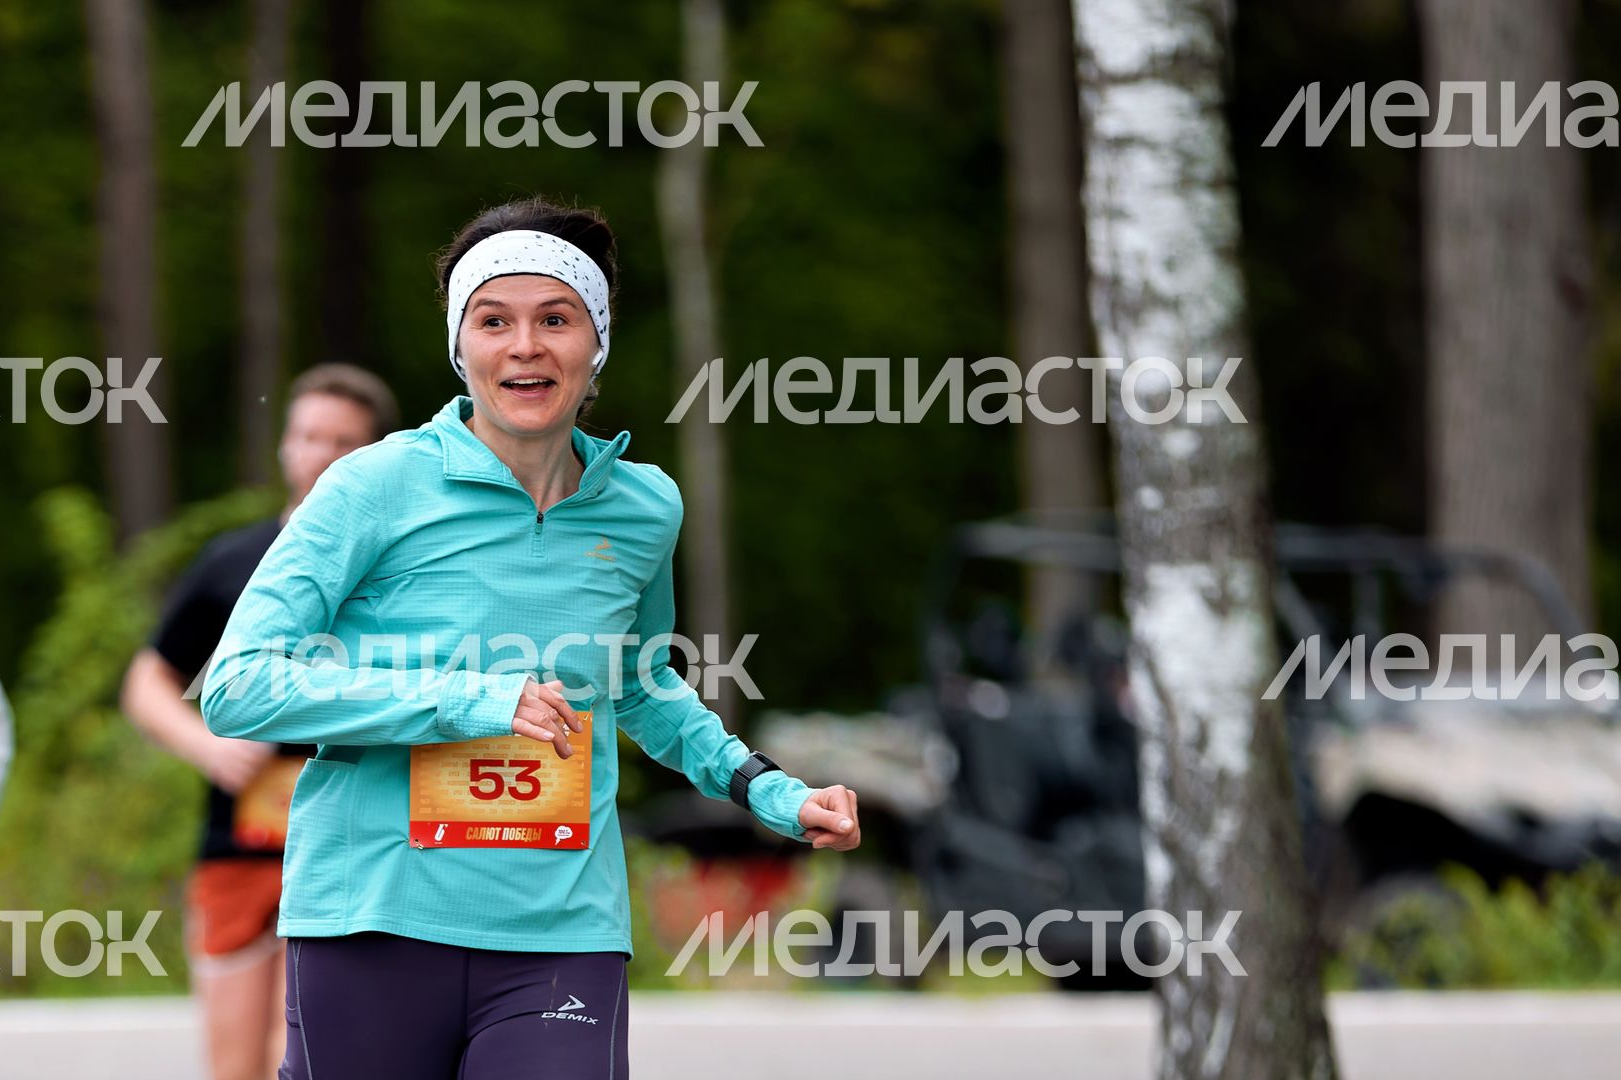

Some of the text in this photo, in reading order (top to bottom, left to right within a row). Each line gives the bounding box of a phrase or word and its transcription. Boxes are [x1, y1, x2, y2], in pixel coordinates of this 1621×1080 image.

[469, 759, 541, 801] 53
[466, 827, 501, 840] САЛЮТ
[502, 827, 542, 842] ПОБЕДЫ
[541, 1012, 599, 1025] DEMIX
